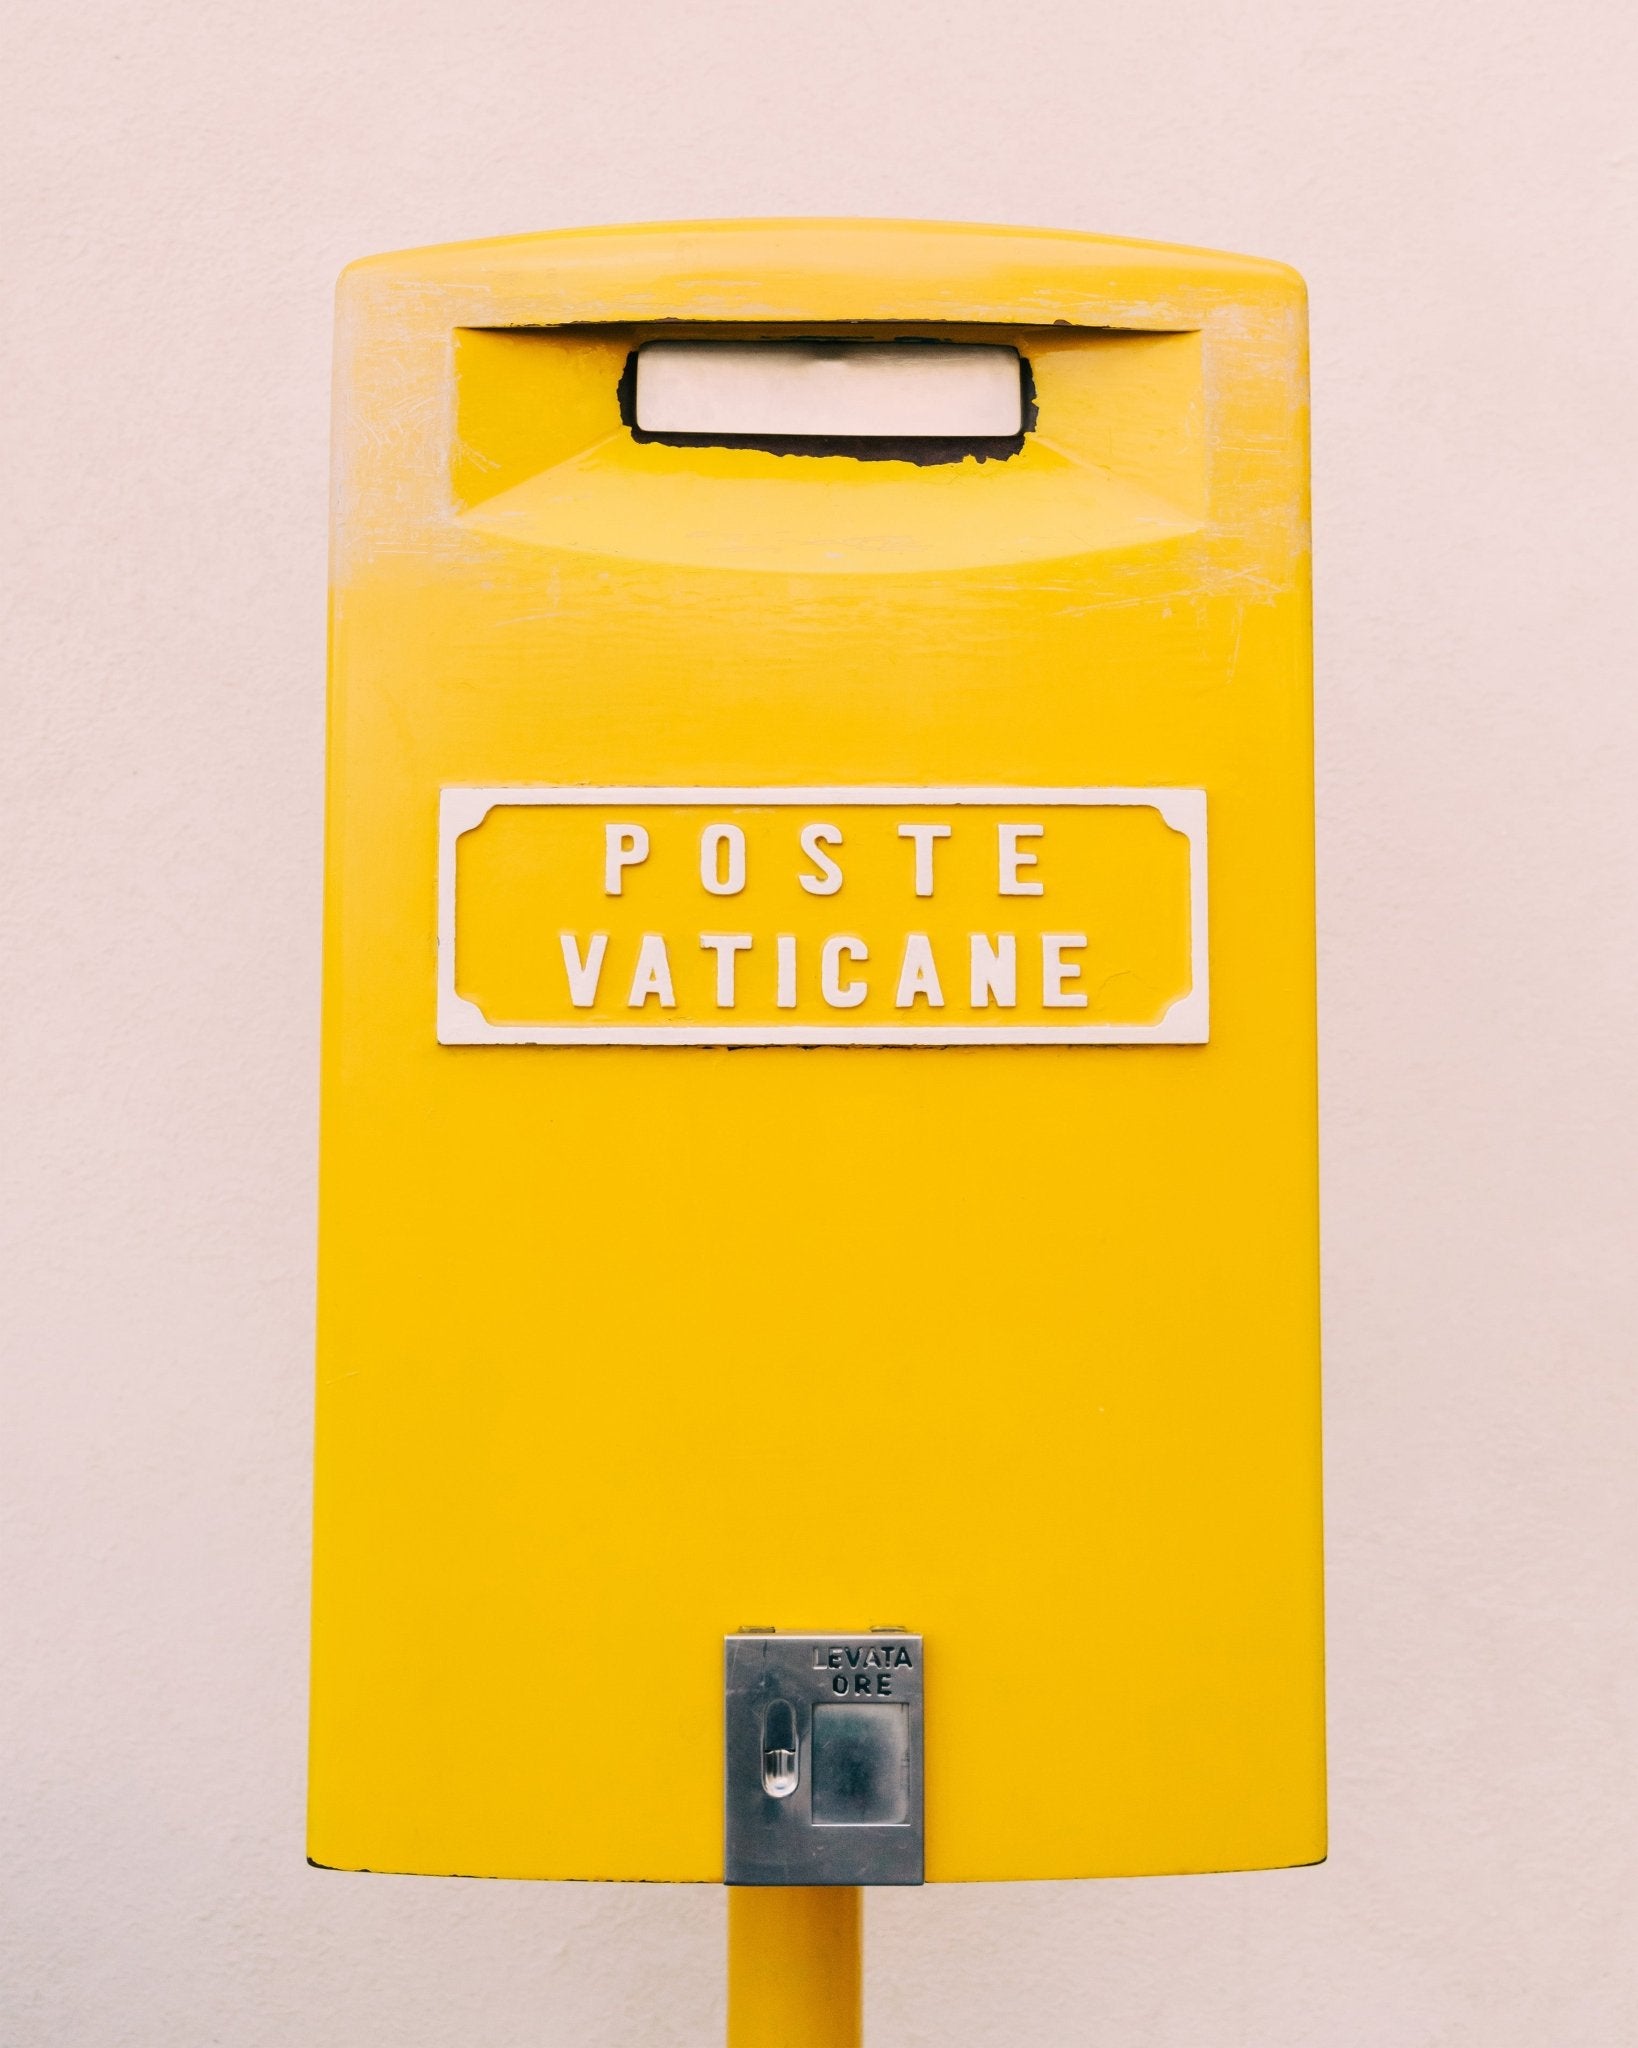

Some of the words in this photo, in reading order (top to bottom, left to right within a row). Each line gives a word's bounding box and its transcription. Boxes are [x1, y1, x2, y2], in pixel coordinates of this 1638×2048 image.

[605, 823, 1044, 896] POSTE
[560, 934, 1088, 1008] VATICANE
[812, 1646, 913, 1670] LEVATA
[832, 1673, 892, 1696] ORE
